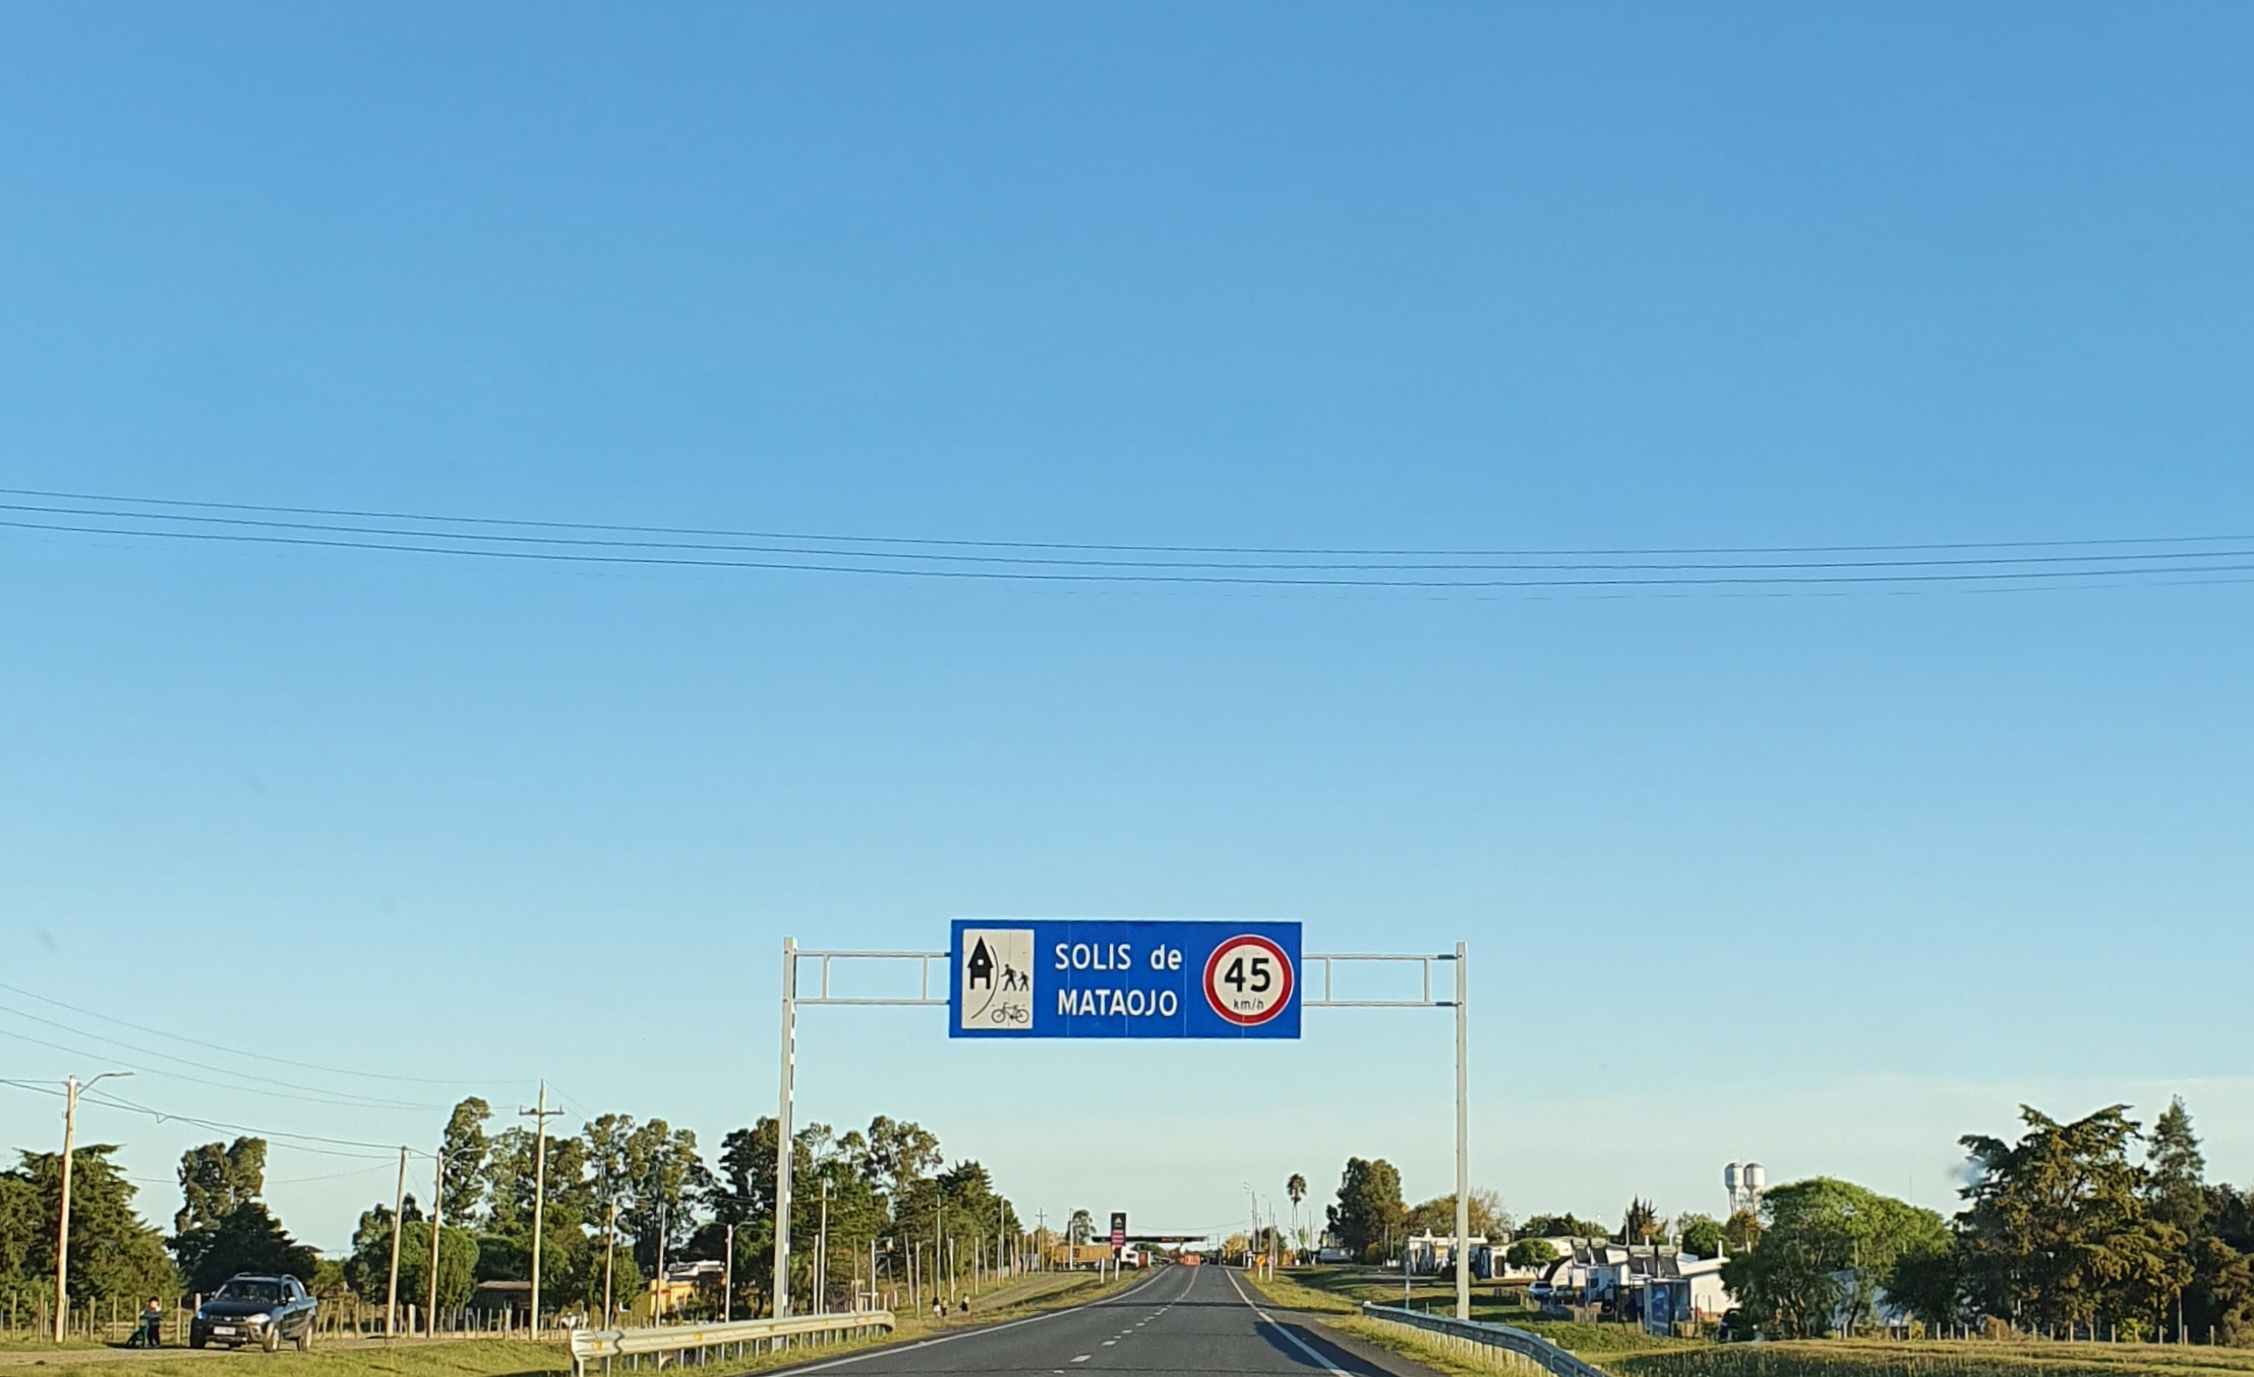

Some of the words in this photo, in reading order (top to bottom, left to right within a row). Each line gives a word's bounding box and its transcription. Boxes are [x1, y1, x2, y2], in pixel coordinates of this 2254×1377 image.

[1055, 943, 1131, 970] SOLIS
[1150, 944, 1182, 970] de
[1224, 957, 1271, 992] 45
[1057, 989, 1178, 1016] MATAOJO
[1233, 998, 1264, 1010] km/h
